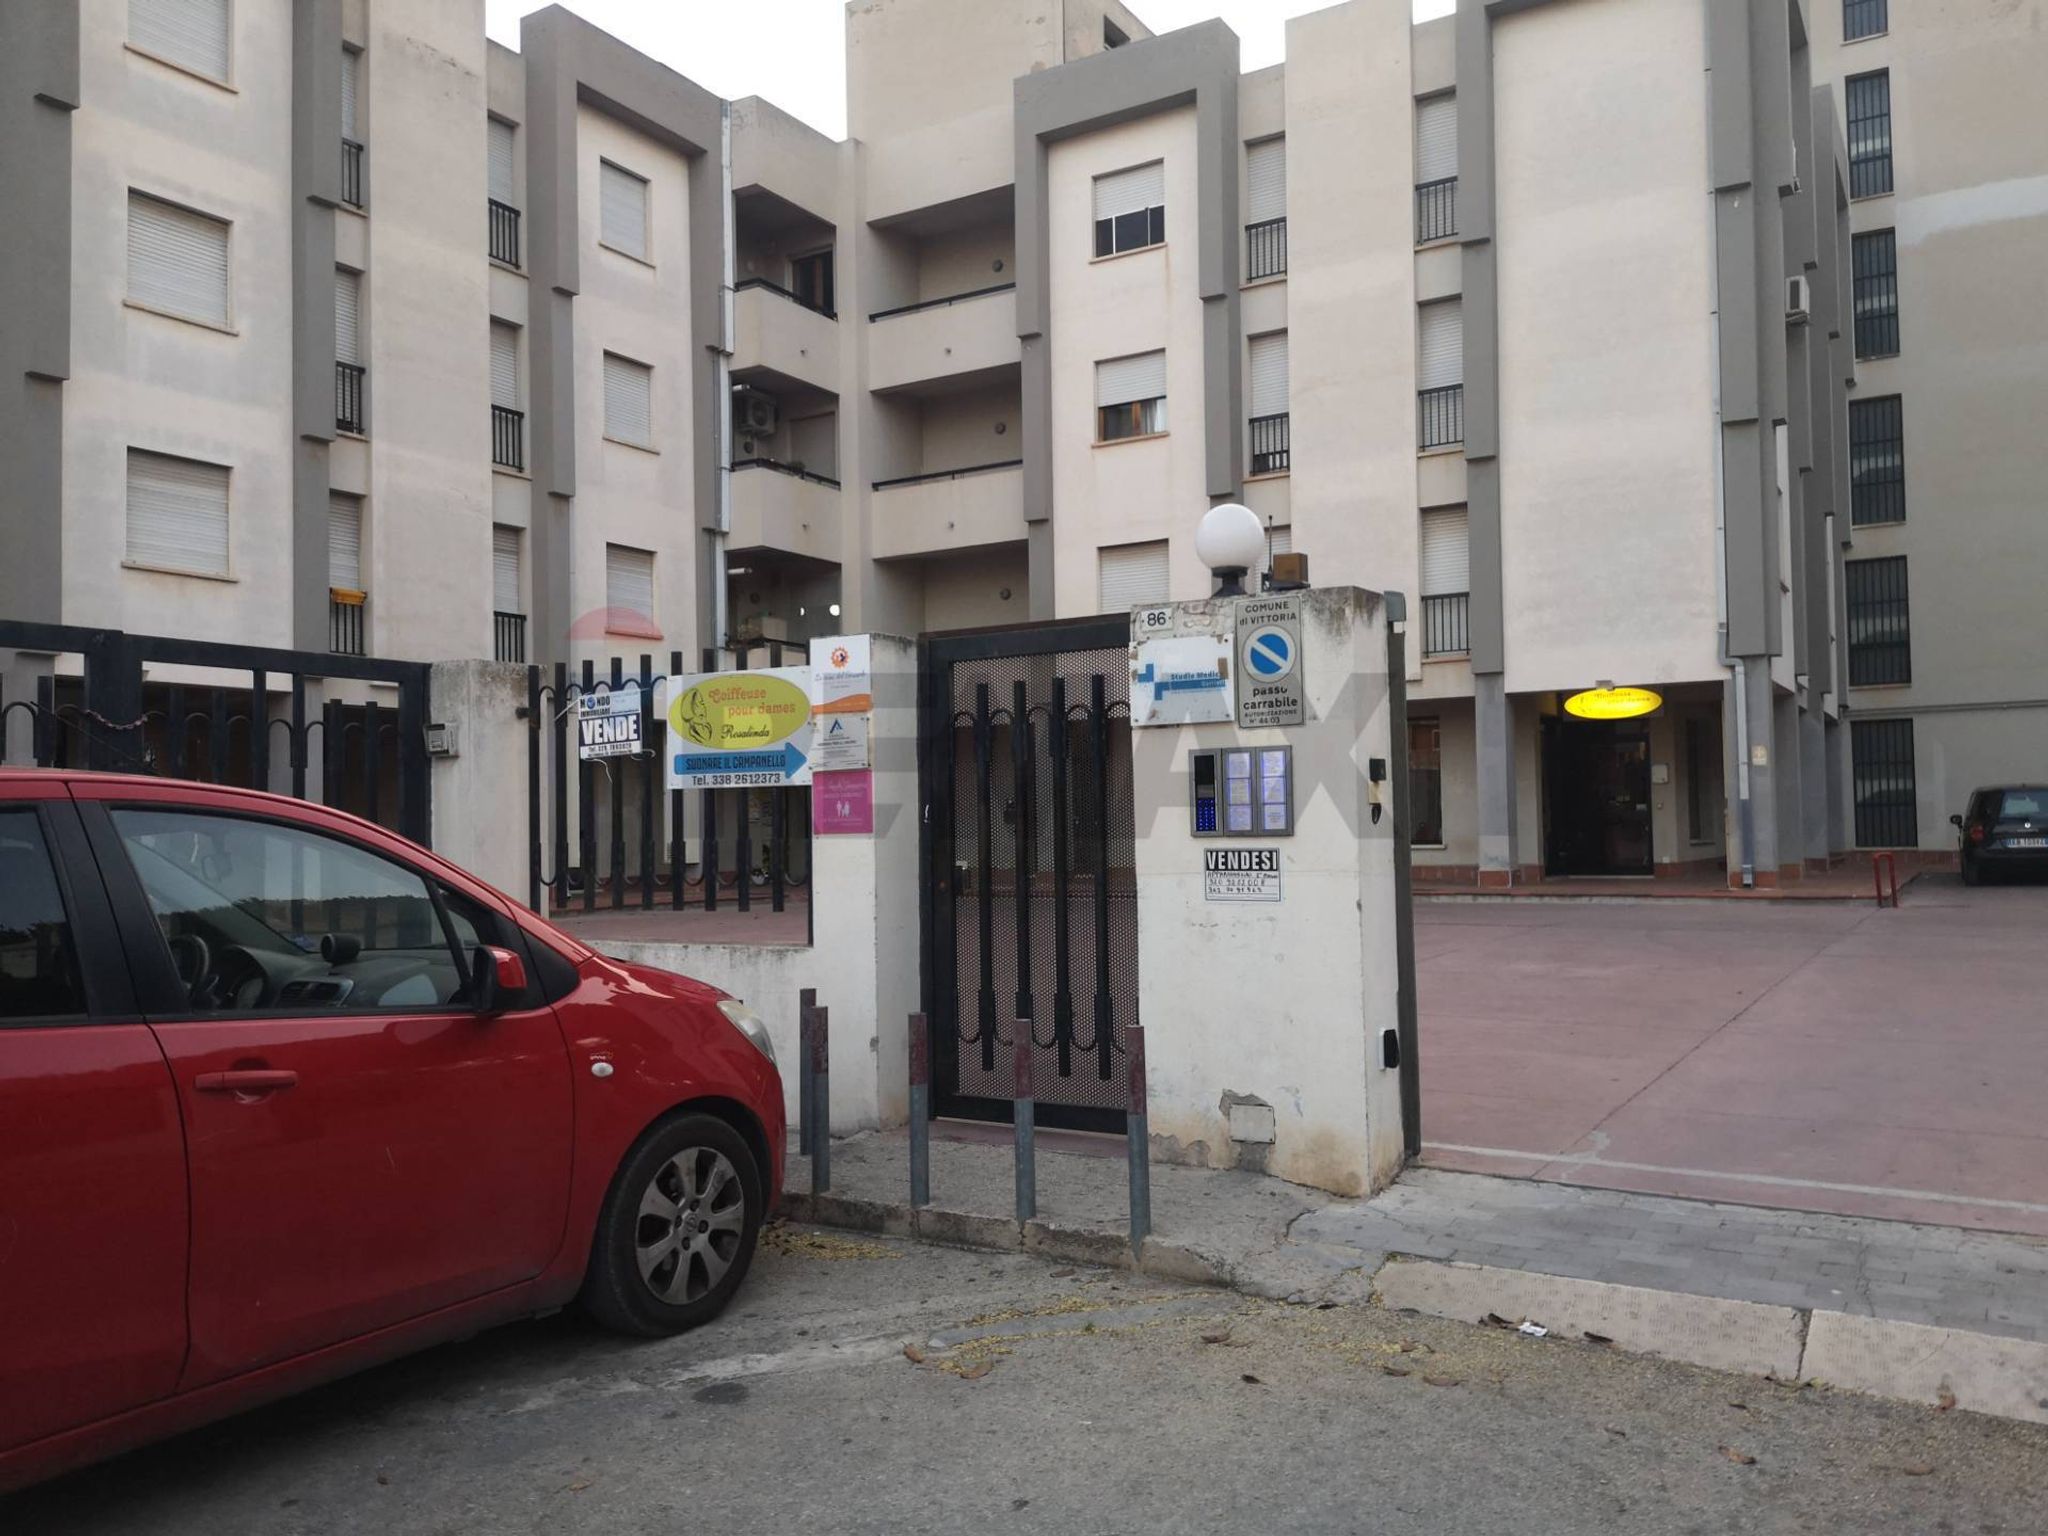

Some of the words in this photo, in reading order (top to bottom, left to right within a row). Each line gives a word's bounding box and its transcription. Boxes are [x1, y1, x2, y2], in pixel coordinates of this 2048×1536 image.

[1245, 601, 1290, 613] COMUNE
[1147, 612, 1166, 626] 86
[1240, 617, 1248, 626] di
[1250, 612, 1297, 624] VITTORIA
[1170, 672, 1195, 680] Studio
[708, 687, 767, 704] Coiffeuse
[1252, 686, 1288, 698] passo
[728, 706, 754, 718] pour
[758, 702, 796, 714] dames
[1243, 696, 1298, 710] carrabile
[581, 714, 638, 745] VENDE
[721, 724, 770, 739] Rosalinda
[686, 758, 722, 771] SUONARE
[724, 757, 731, 769] IL
[733, 755, 786, 769] CAMPANELLO
[691, 775, 710, 786] Tel.
[712, 774, 732, 785] 338
[734, 773, 781, 785] 2612373
[1207, 851, 1277, 870] VENDESI
